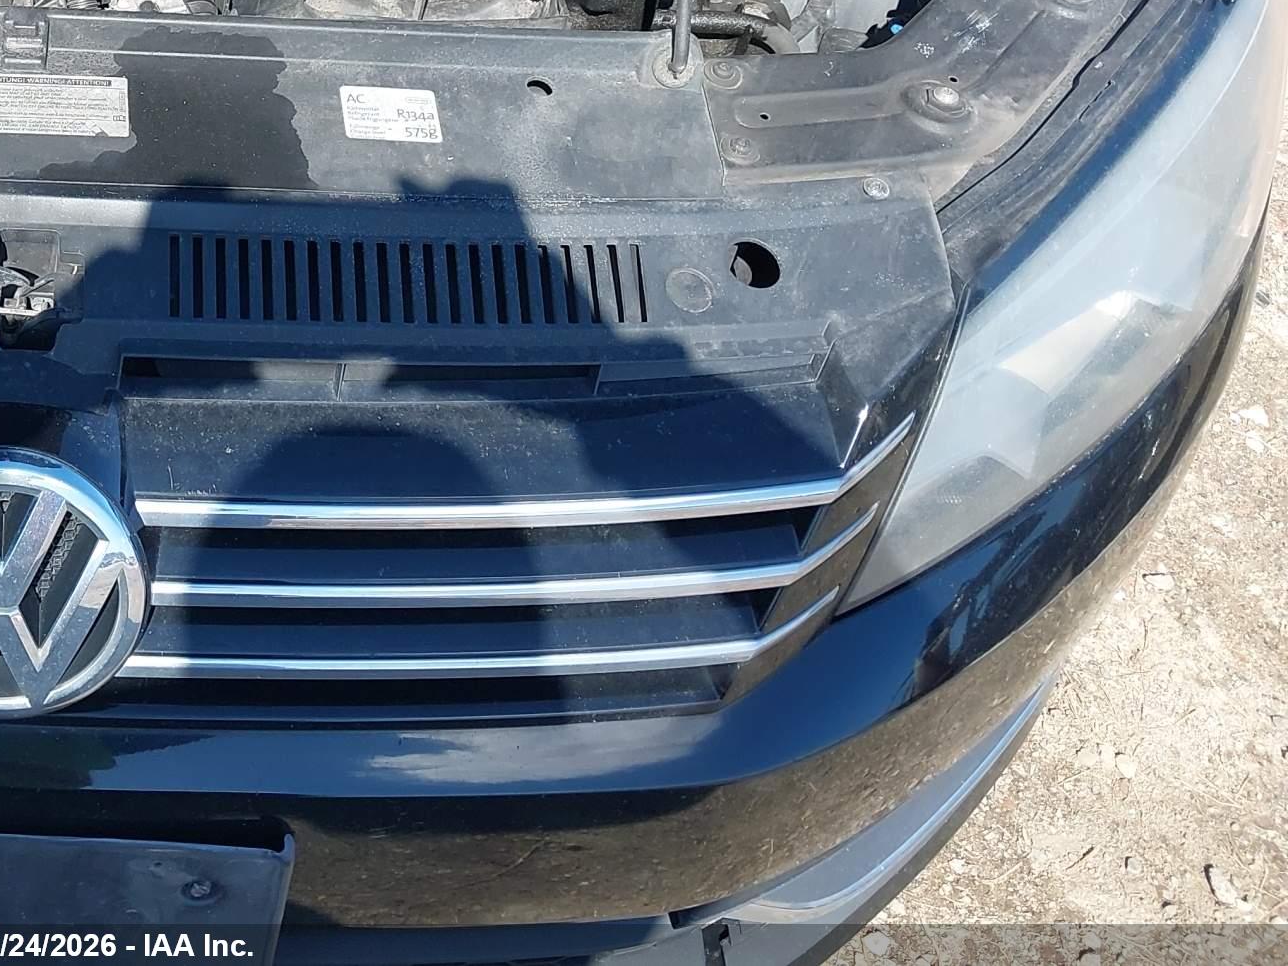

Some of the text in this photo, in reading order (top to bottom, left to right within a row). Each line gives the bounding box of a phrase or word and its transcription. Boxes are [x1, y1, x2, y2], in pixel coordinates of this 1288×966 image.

[27, 77, 65, 85] WARNING!
[66, 79, 110, 87] ATTENTION!
[346, 93, 367, 104] AC
[396, 108, 435, 122] R134a
[404, 127, 439, 140] 575g
